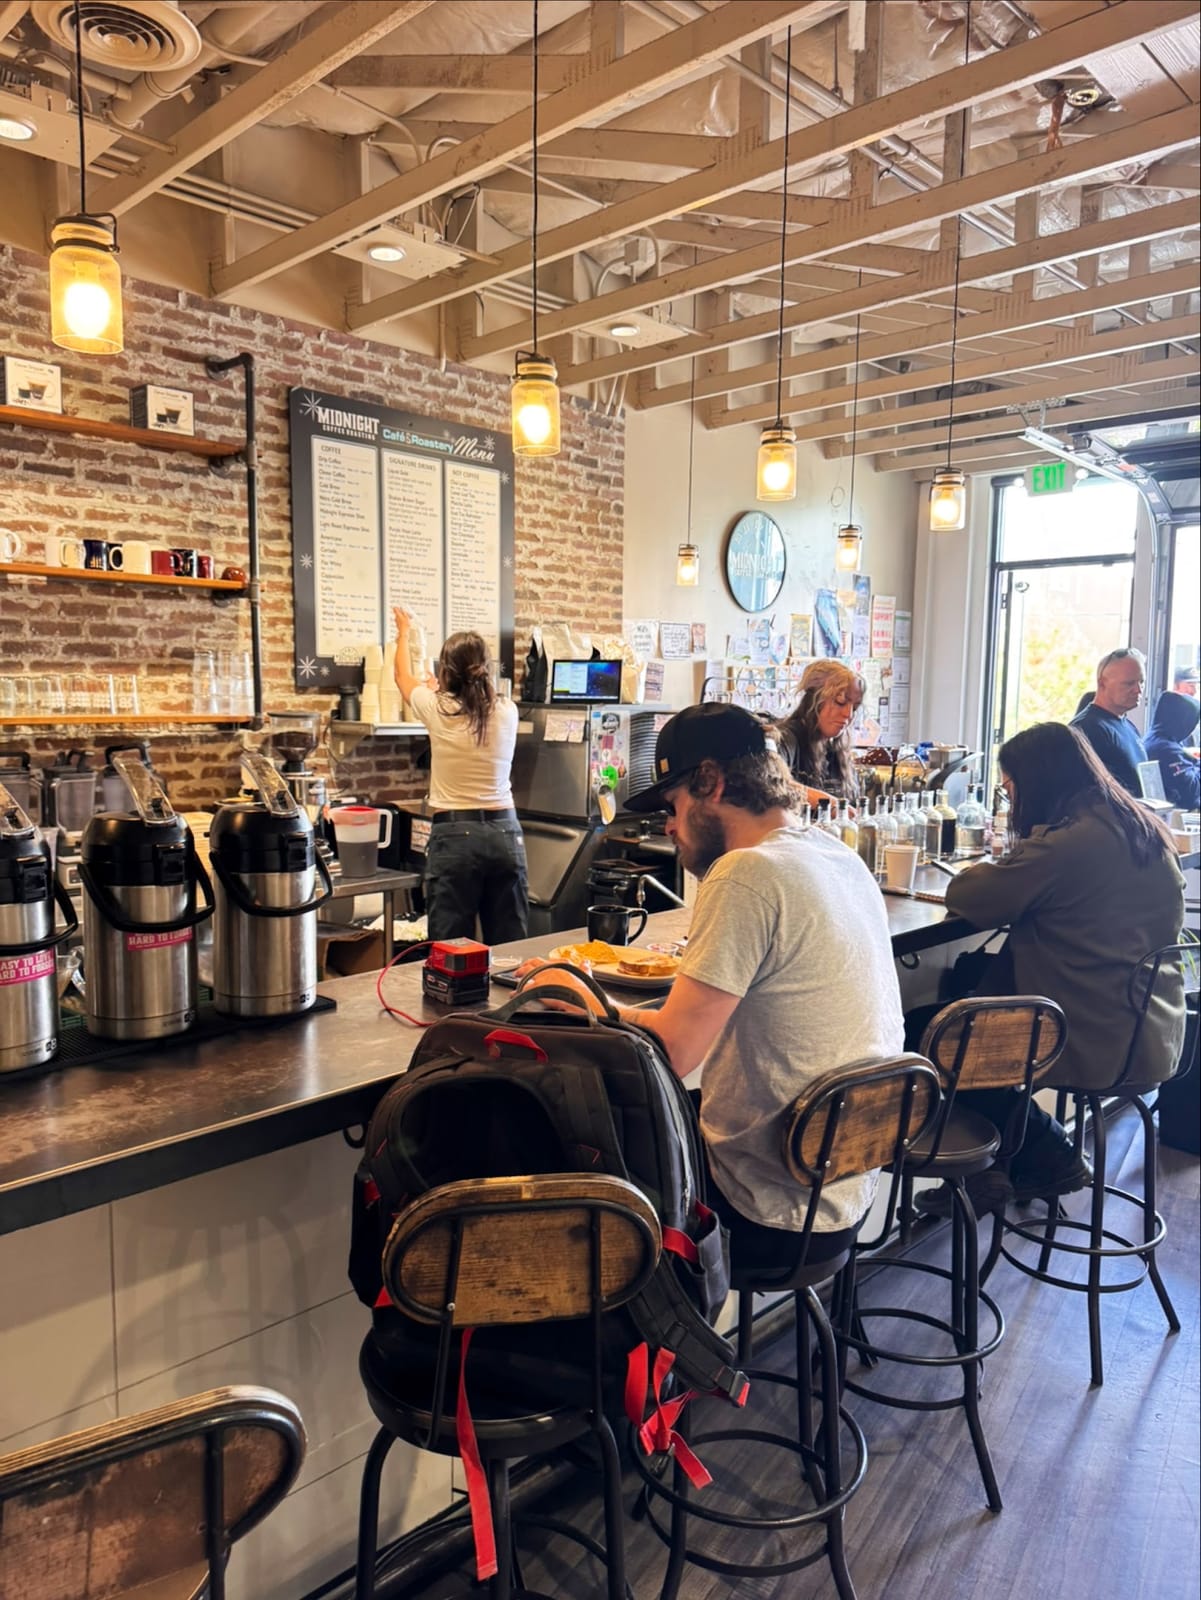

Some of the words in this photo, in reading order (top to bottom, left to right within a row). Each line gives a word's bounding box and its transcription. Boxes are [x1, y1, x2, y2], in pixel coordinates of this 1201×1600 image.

[317, 406, 380, 435] MIDNIGHT
[322, 424, 345, 435] COFFEE
[346, 428, 376, 440] ROASTING
[382, 428, 405, 442] Café
[411, 435, 454, 455] Roastery
[453, 435, 496, 462] Menu
[321, 445, 342, 454] COFFEE
[388, 456, 417, 468] SIGNATURE
[1032, 462, 1066, 494] EXIT
[128, 935, 155, 945] HARD
[0, 959, 20, 970] ASY
[23, 957, 34, 967] TO
[18, 967, 30, 977] TO
